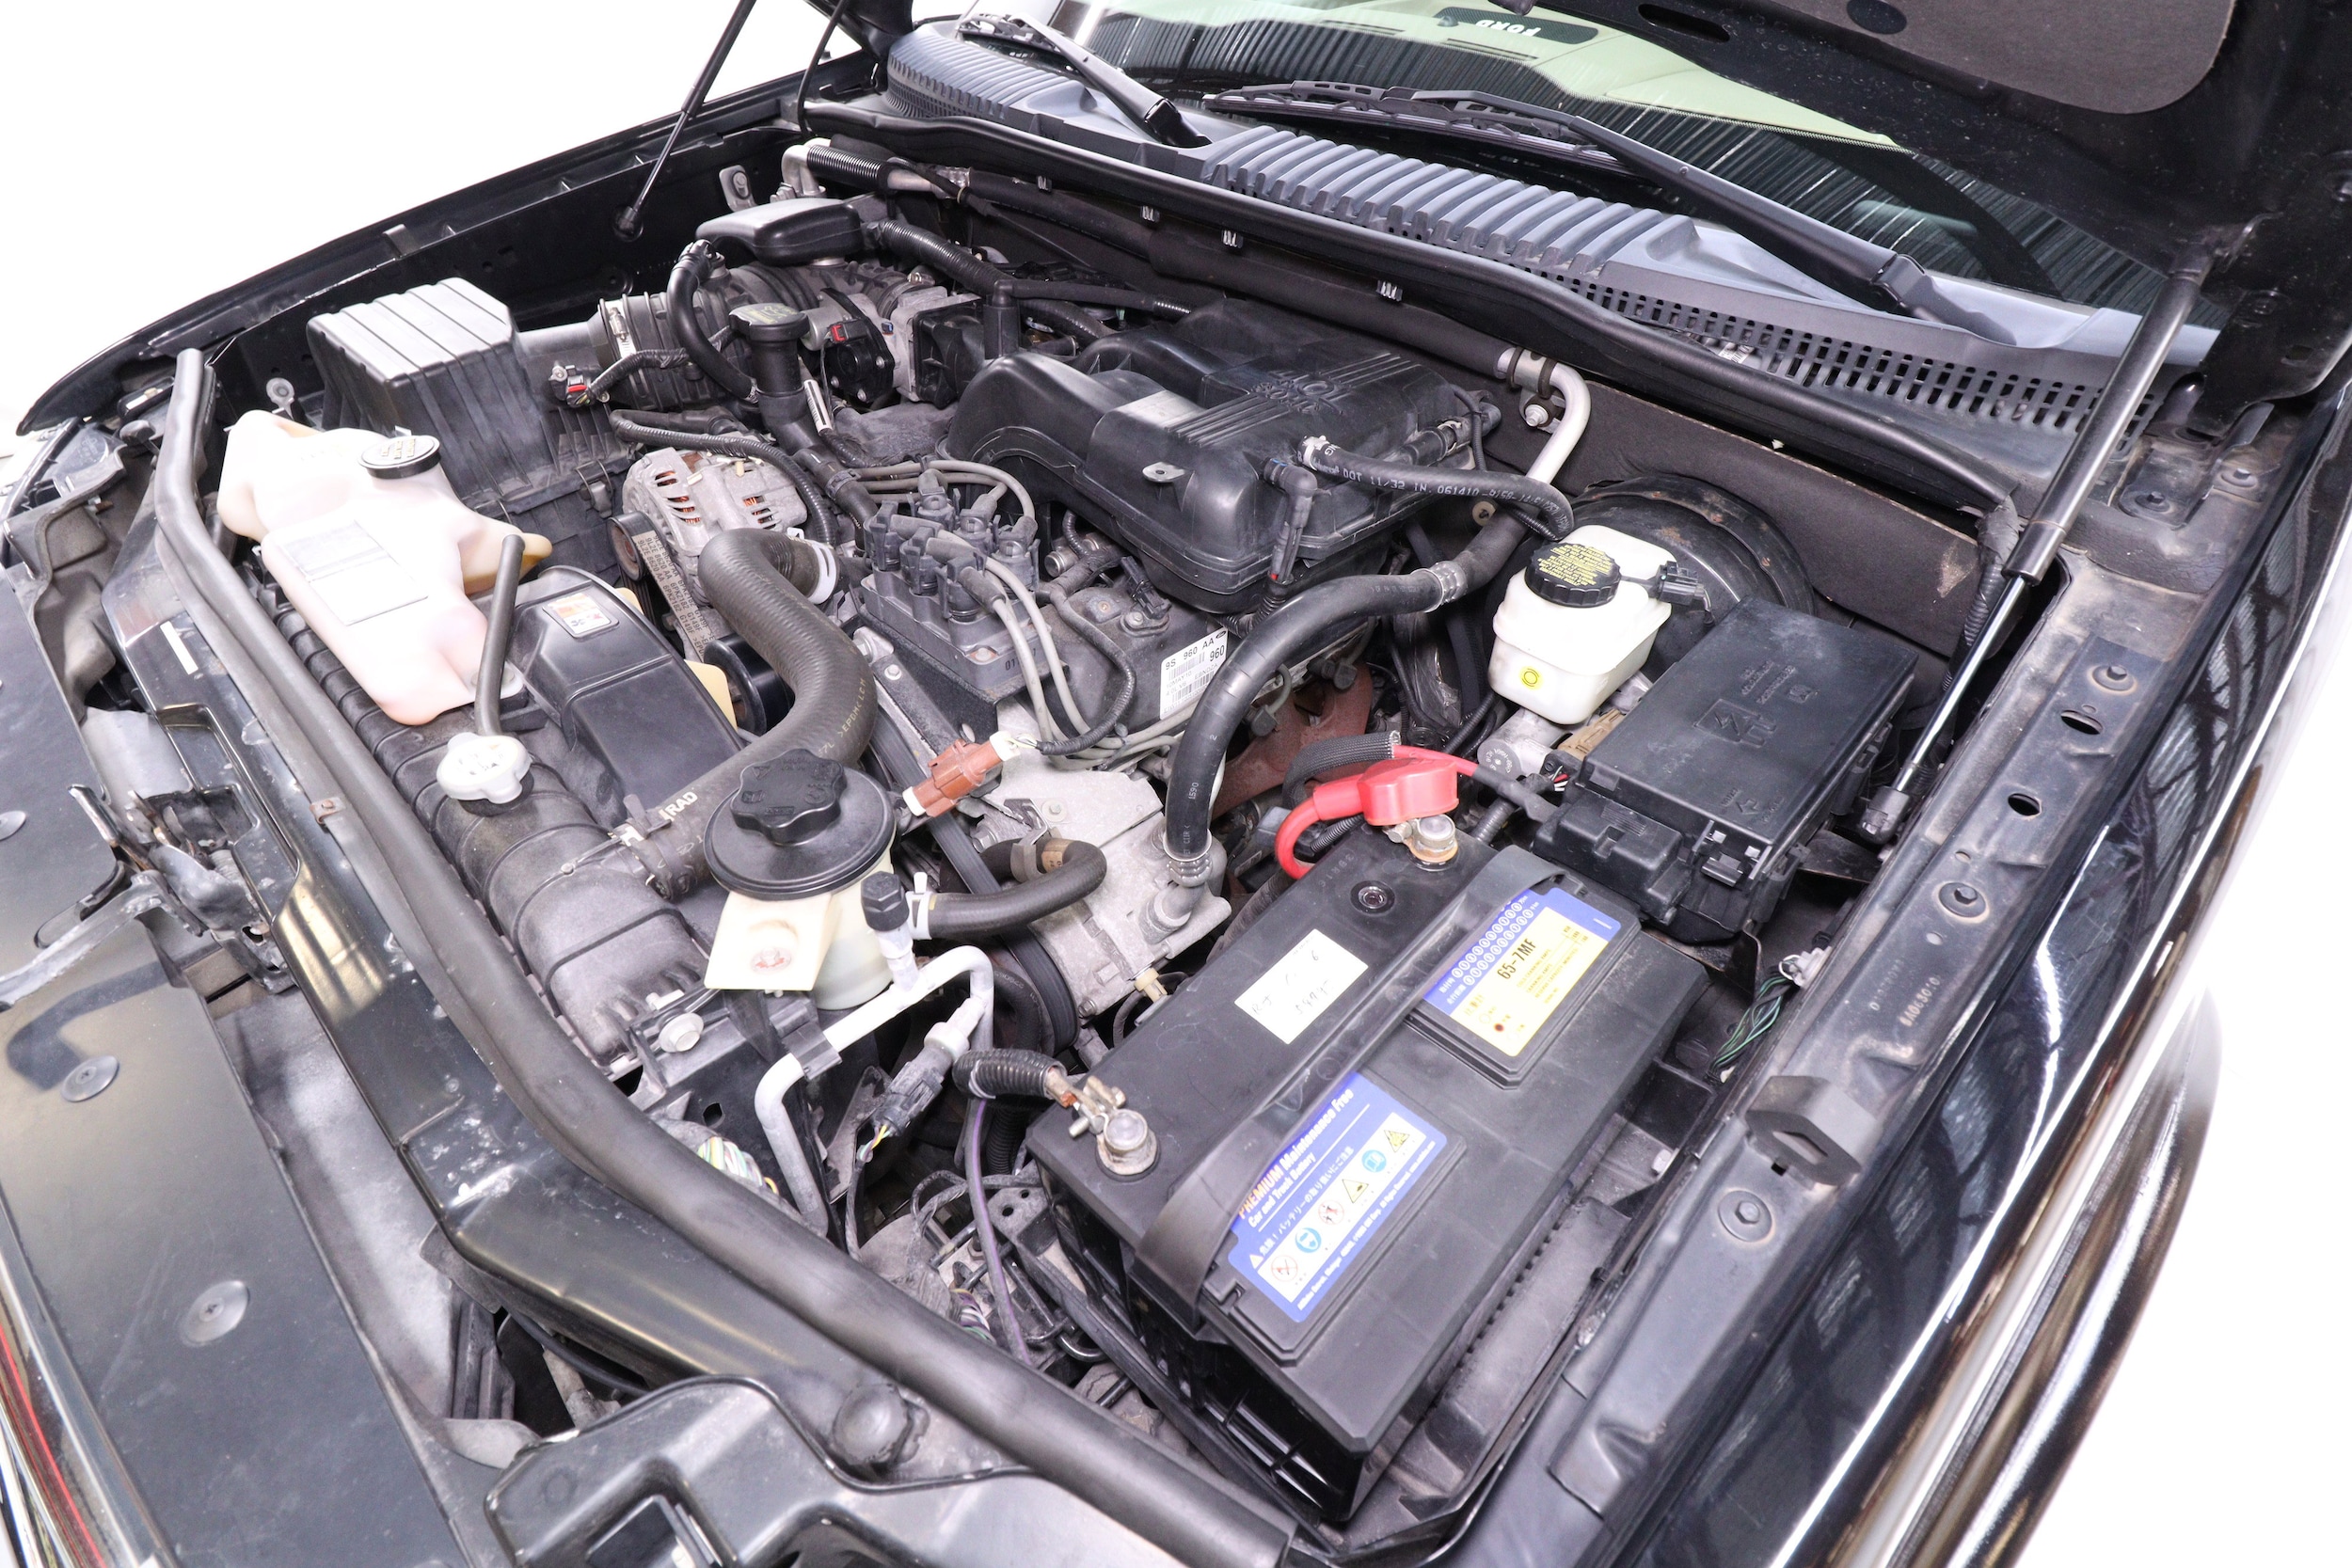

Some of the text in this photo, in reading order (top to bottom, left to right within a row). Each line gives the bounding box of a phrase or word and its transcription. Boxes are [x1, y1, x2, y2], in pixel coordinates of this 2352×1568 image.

[1475, 19, 1541, 37] FORD
[1343, 468, 1362, 483] DOT
[1370, 475, 1406, 489] 11/32
[1437, 484, 1479, 496] 061410
[637, 539, 650, 556] 9L2E
[646, 555, 660, 572] 8620
[655, 571, 664, 581] AA
[644, 537, 657, 553] 9L2E
[654, 554, 667, 570] 8620
[662, 569, 672, 579] AA
[1166, 638, 1215, 670] 9S 960 AA
[1210, 644, 1225, 661] 960
[665, 791, 698, 816] RAD
[1187, 781, 1200, 800] 1590
[1497, 936, 1536, 979] 65-7MF
[1237, 1087, 1354, 1218] PREMIUM Maintenance Free
[1248, 1151, 1315, 1227] Car and Truck Battery
